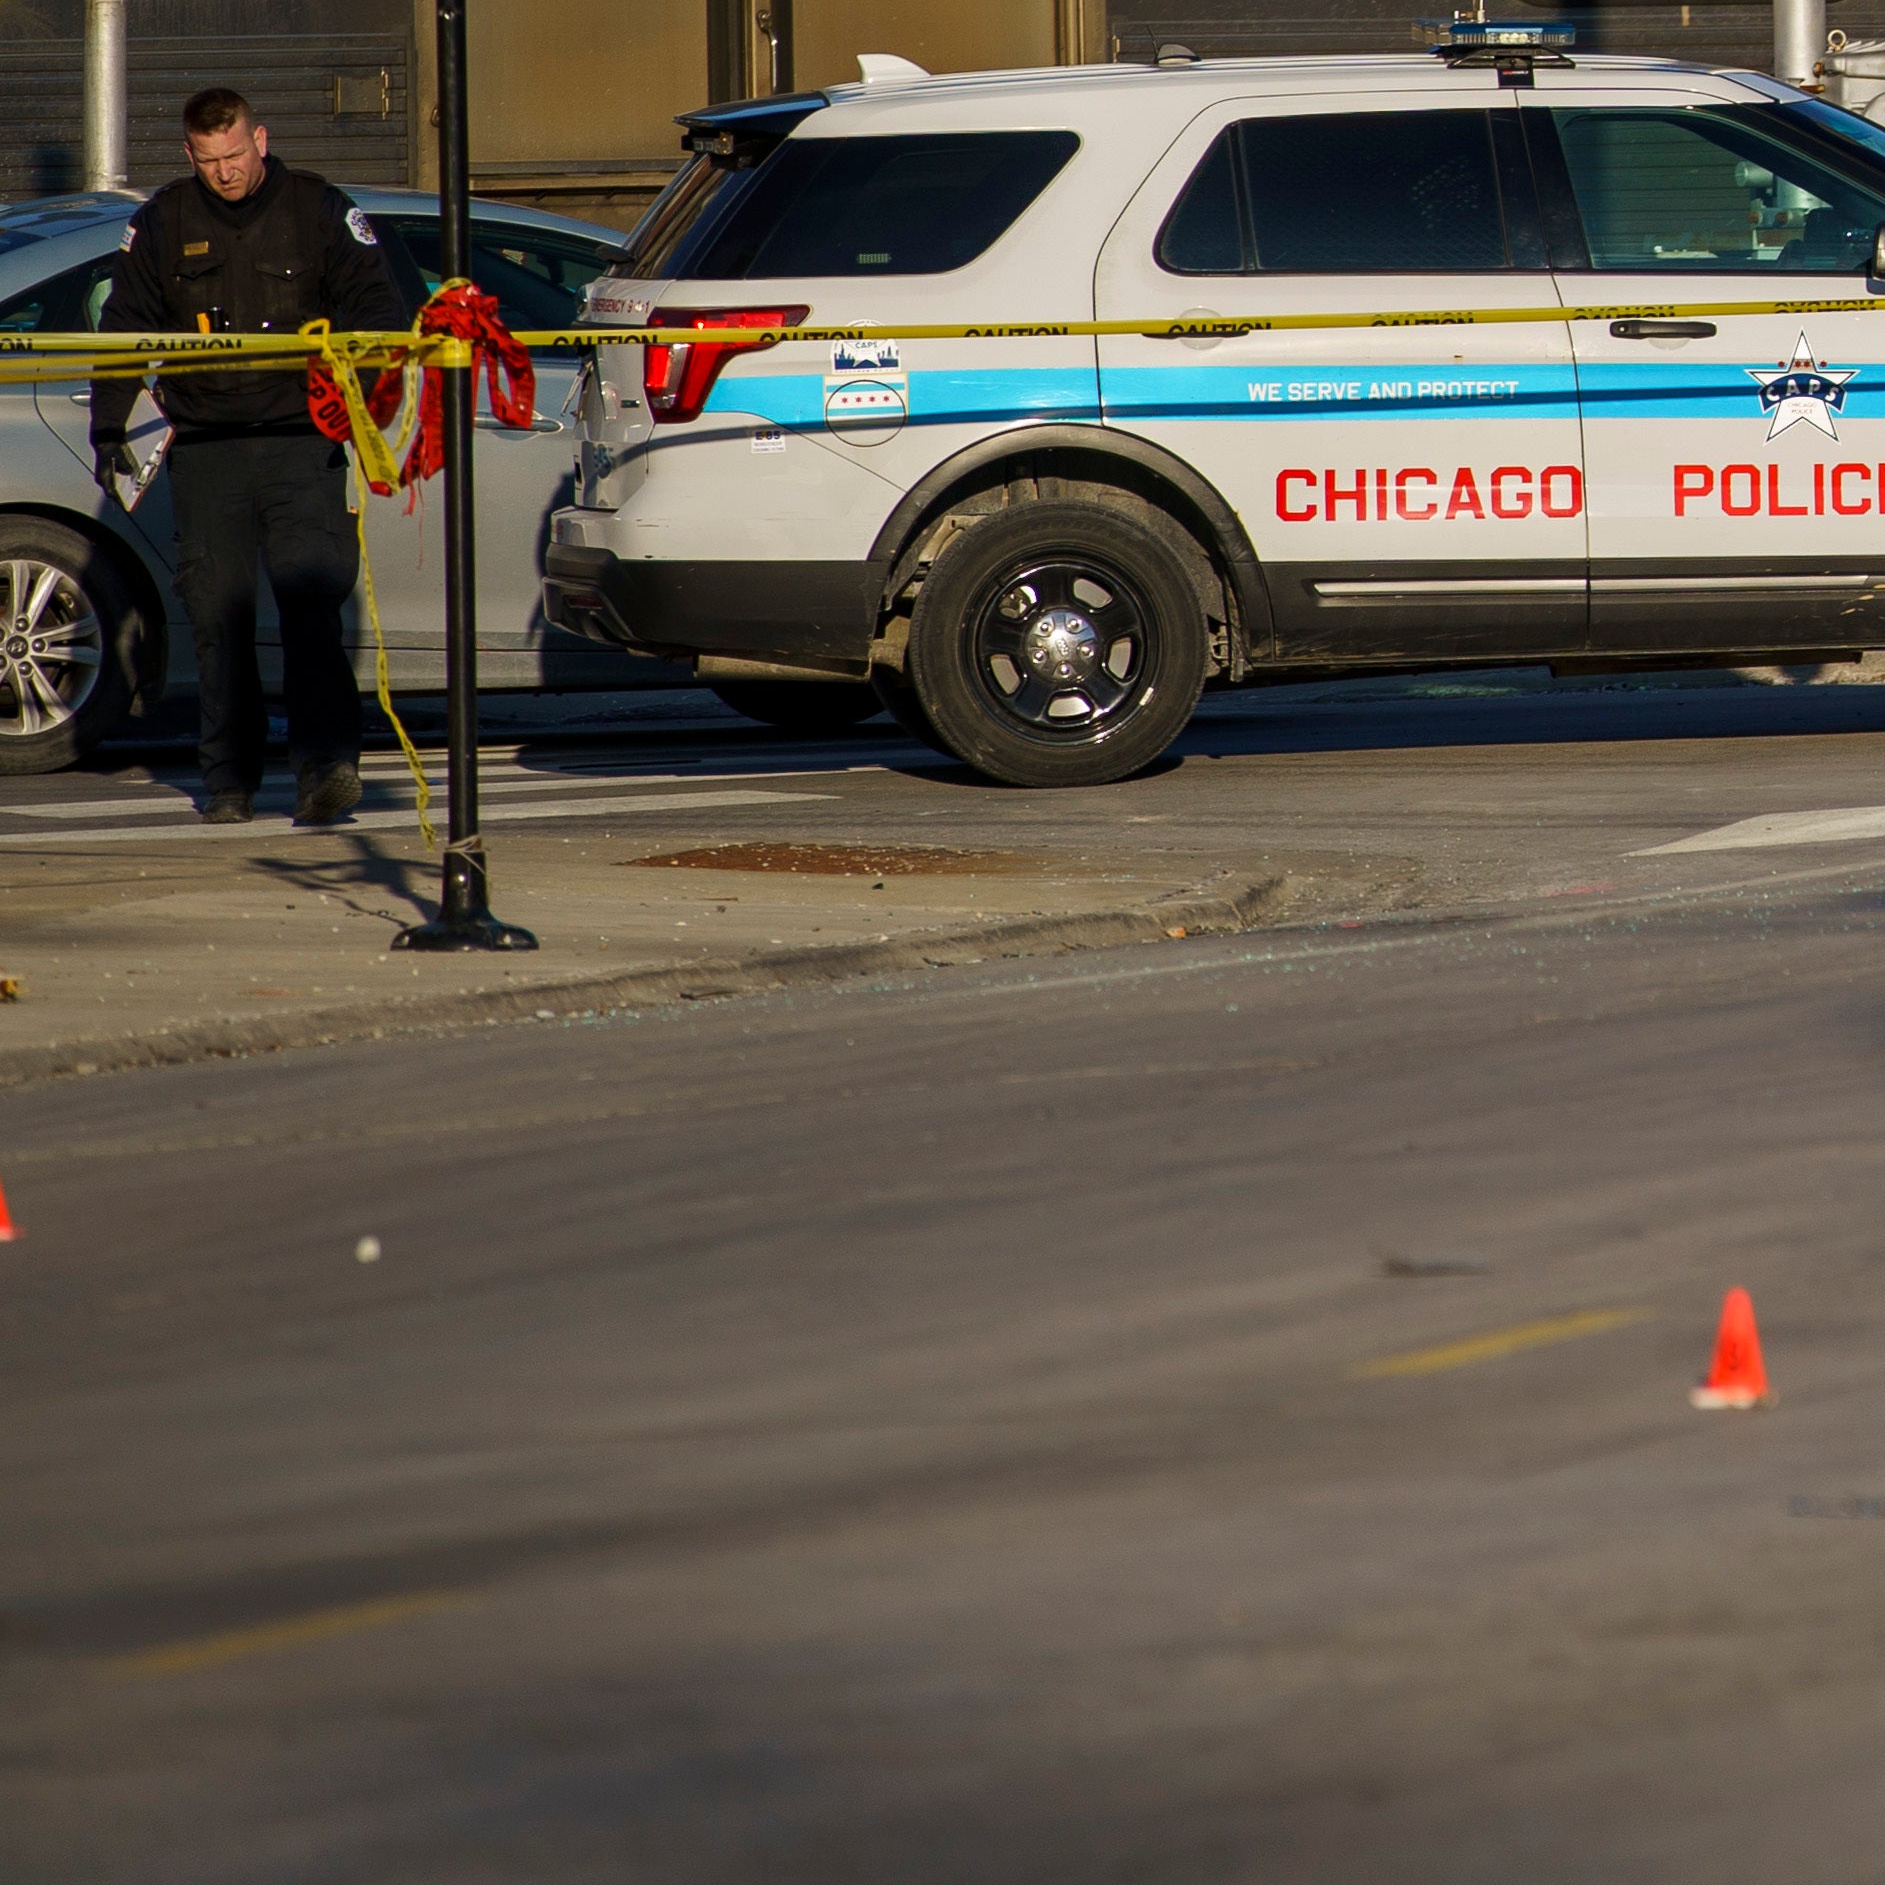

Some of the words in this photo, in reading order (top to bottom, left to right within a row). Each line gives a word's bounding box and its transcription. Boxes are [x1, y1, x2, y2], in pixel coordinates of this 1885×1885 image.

[1247, 382, 1284, 402] WE
[1287, 382, 1362, 402] SERVE
[1368, 381, 1413, 401] AND
[1417, 380, 1520, 401] PROTECT
[1766, 378, 1840, 402] CAPS
[1275, 464, 1583, 523] CHICAGO
